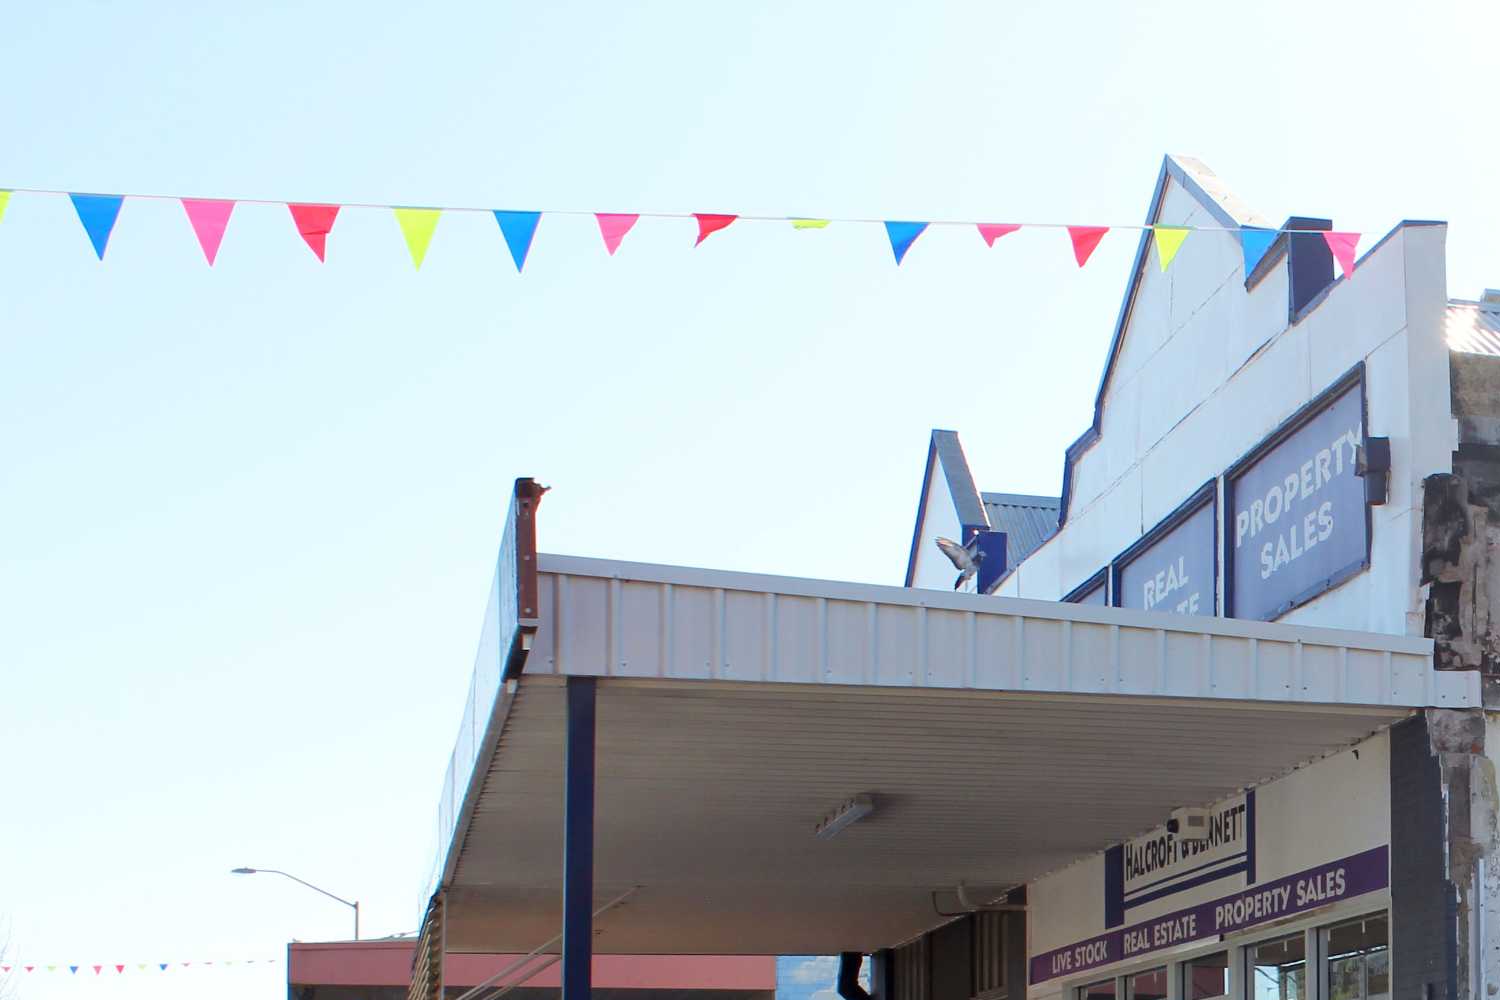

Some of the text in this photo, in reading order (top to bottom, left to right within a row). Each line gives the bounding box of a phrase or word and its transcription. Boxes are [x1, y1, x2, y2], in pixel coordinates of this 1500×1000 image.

[1236, 421, 1363, 549] PROPERTY
[1143, 556, 1189, 611] REAL
[1260, 501, 1334, 580] SALES
[1052, 868, 1346, 975] LIVE STOCK REAL ESTATE PROPERTY SALES
